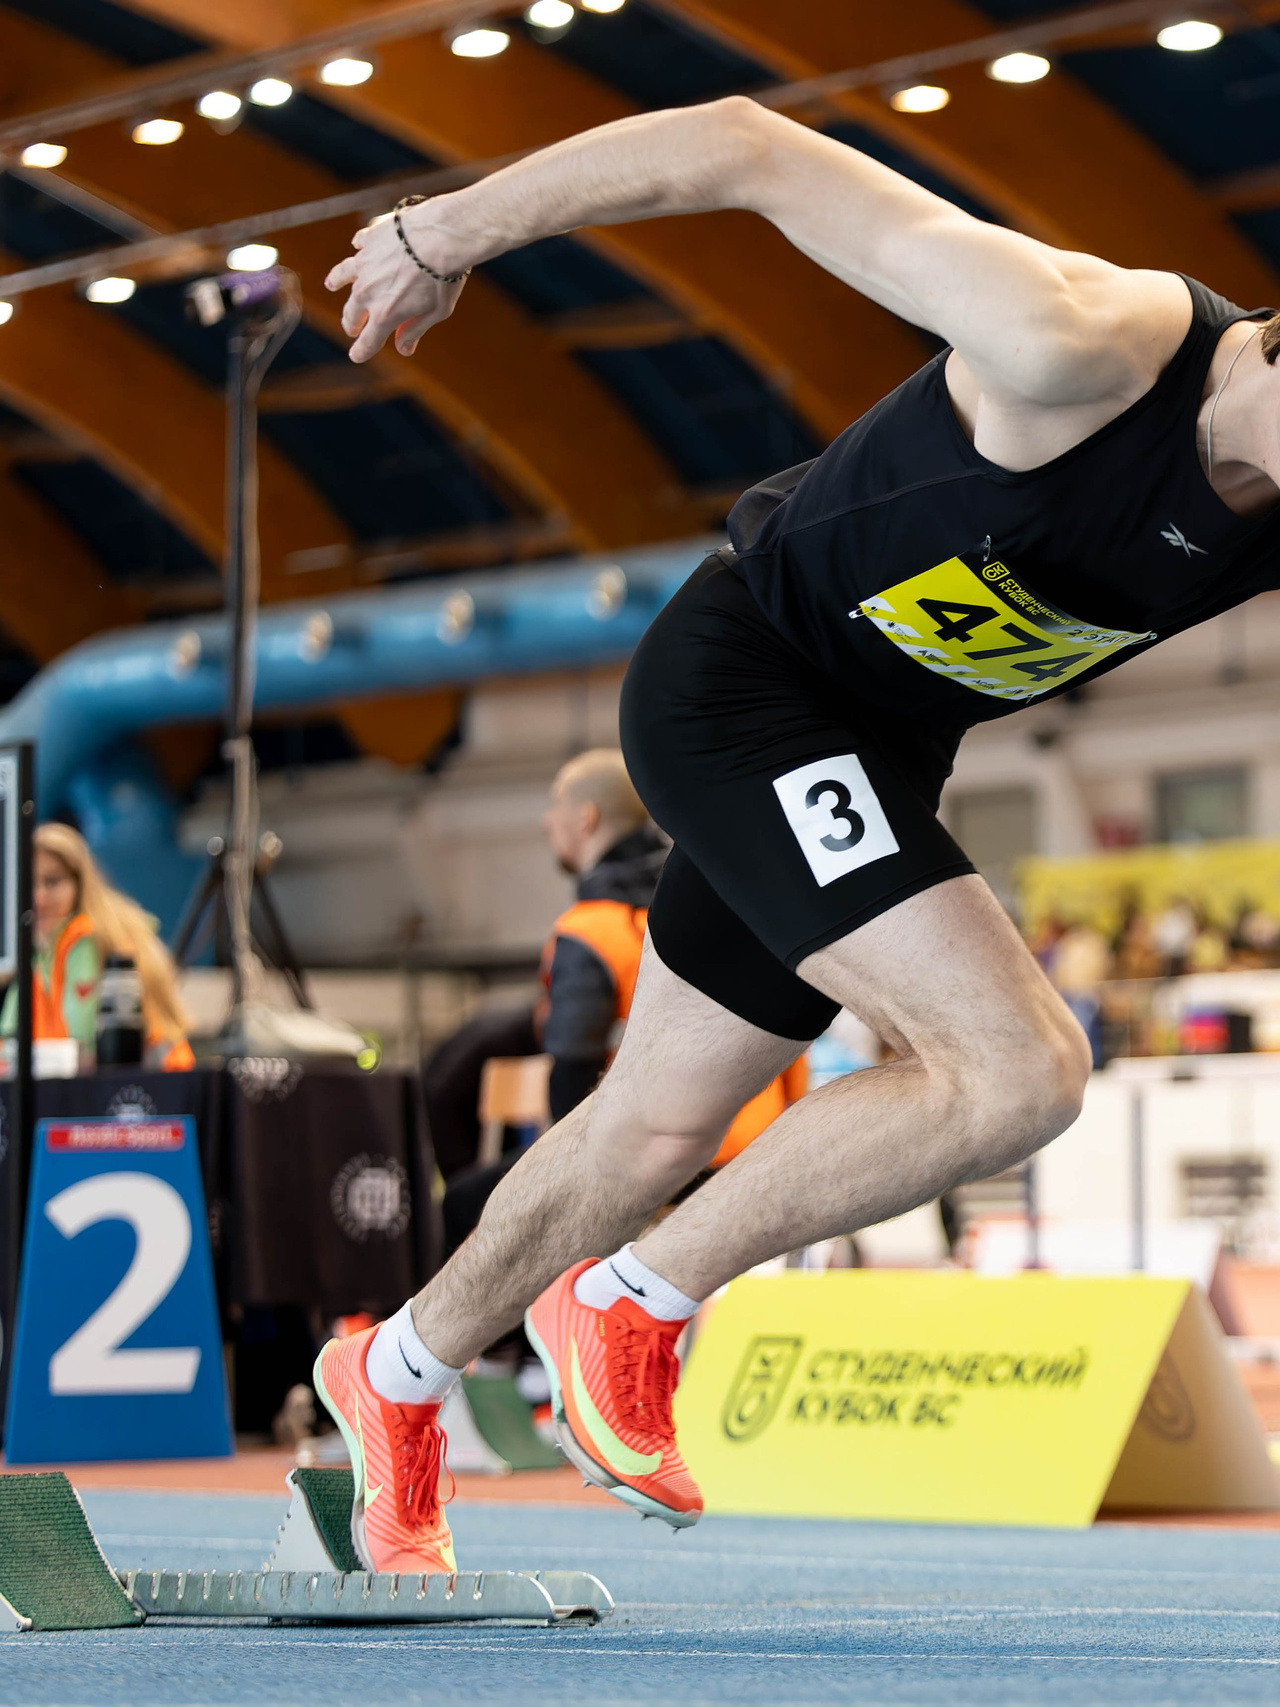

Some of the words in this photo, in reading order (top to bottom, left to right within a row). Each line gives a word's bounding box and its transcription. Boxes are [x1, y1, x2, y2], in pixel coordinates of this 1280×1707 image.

[998, 582, 1028, 607] КУБОК
[1006, 578, 1072, 626] СТУДЕНЧЕСКИЙ
[916, 597, 1095, 683] 474
[805, 779, 866, 853] 3
[45, 1171, 202, 1396] 2
[807, 1346, 1090, 1390] СТУДЕНЧЕСКИЙ
[789, 1391, 904, 1428] КУБОК
